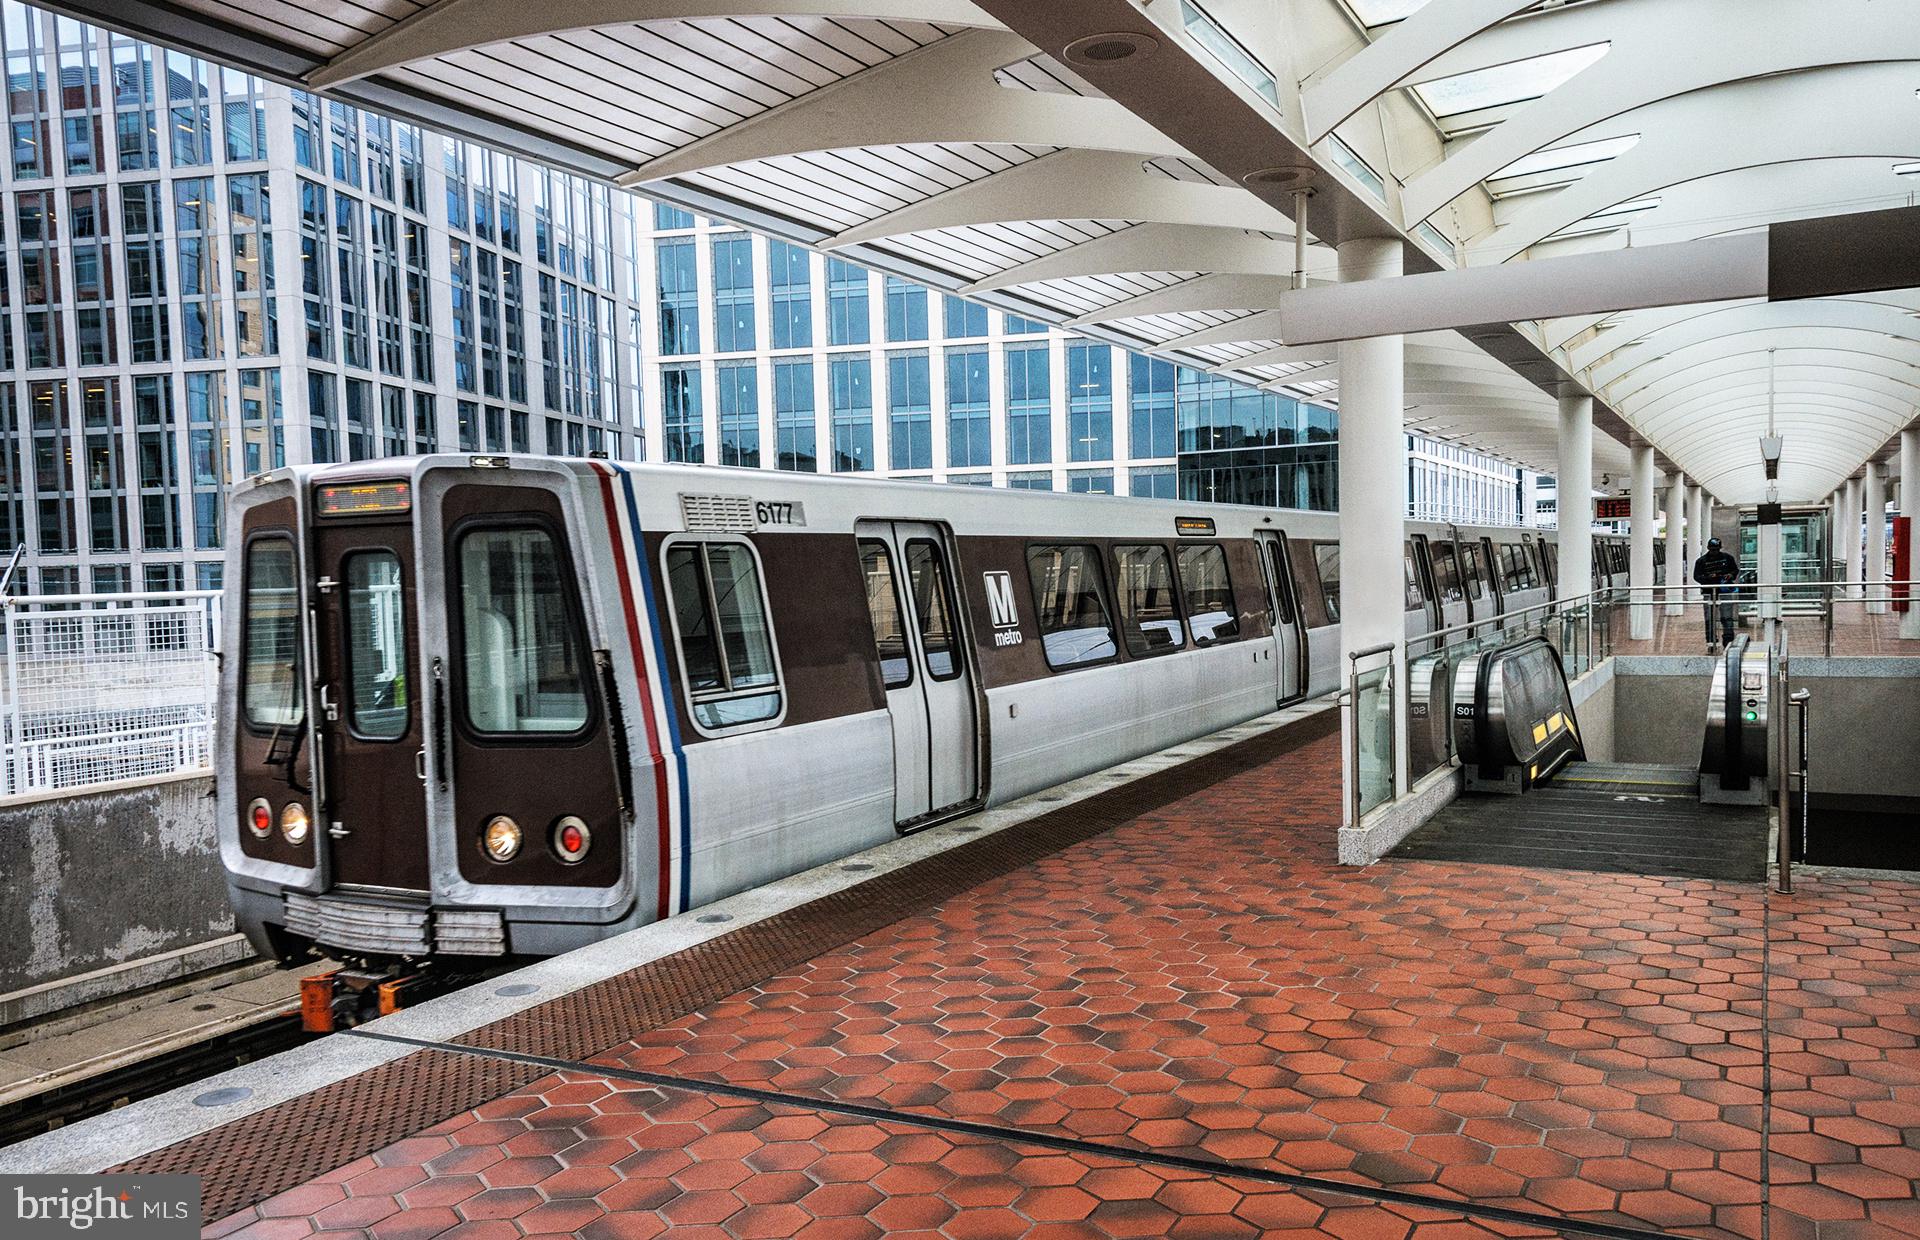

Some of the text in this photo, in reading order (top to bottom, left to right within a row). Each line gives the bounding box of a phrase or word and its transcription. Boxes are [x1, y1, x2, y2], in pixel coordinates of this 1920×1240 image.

[756, 501, 792, 524] 6177
[985, 575, 1017, 625] M
[994, 629, 1022, 646] metro
[1456, 706, 1474, 716] S01
